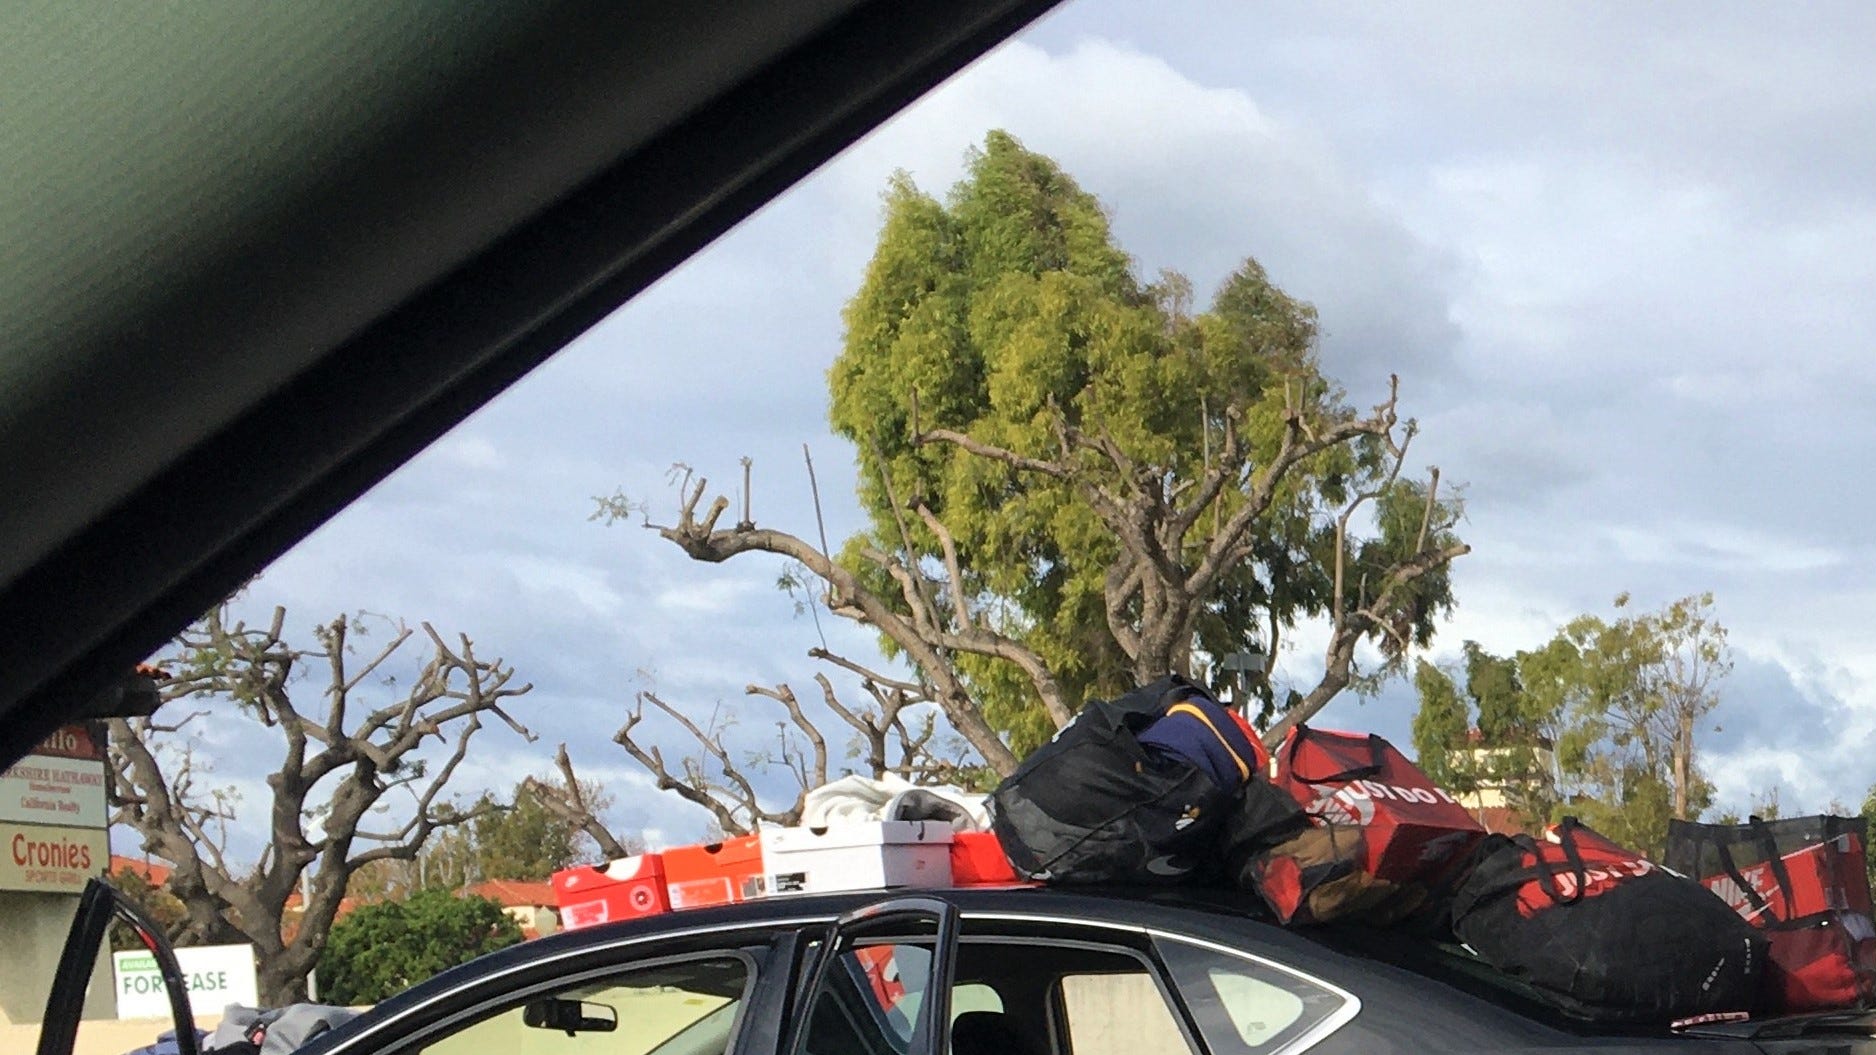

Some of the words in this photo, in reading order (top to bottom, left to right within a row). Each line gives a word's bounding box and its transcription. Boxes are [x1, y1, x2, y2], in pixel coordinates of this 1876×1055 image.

[1393, 786, 1438, 804] DO
[12, 833, 91, 869] Cronies
[123, 974, 164, 994] FOR
[182, 971, 228, 991] EASE
